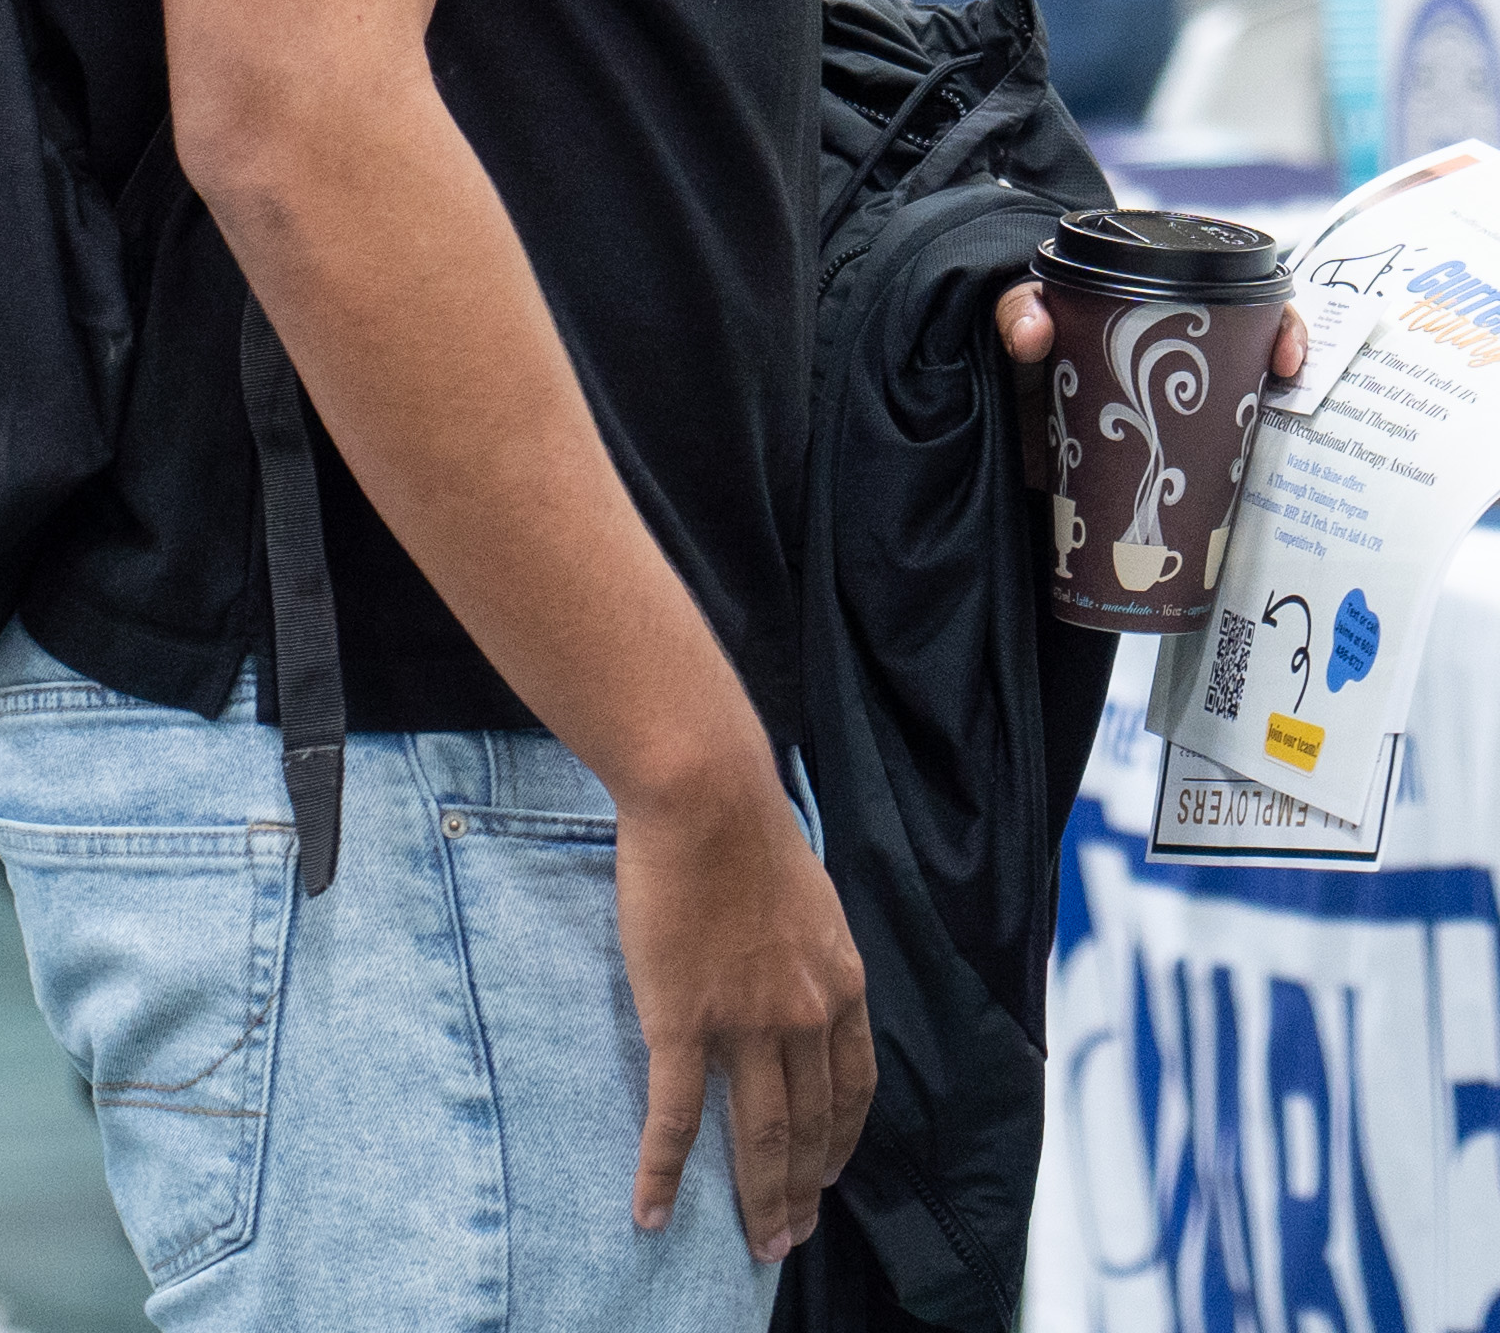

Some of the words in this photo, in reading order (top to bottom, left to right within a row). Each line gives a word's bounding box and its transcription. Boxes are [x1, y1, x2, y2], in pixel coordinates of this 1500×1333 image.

[1341, 366, 1359, 383] art
[1358, 373, 1388, 396] Time
[1384, 385, 1404, 402] Ed
[1399, 391, 1430, 412] Tech
[1359, 342, 1380, 363] Part
[1380, 348, 1410, 373] Time
[1407, 364, 1428, 379] Ed
[1424, 369, 1455, 392] Tech
[1320, 396, 1370, 424] upational
[1369, 410, 1421, 442] Therapists
[1257, 410, 1291, 434] rtified
[1290, 419, 1352, 453] Occupational
[1348, 440, 1389, 469] Therapy
[1388, 457, 1439, 487] Assistants
[1285, 452, 1310, 473] Watch
[1309, 460, 1322, 477] Me
[1320, 466, 1343, 485] Shine
[1266, 472, 1275, 486] A
[1273, 474, 1309, 501] Thorough
[1307, 485, 1339, 513] Training
[1336, 498, 1370, 521] Program
[1273, 526, 1316, 553] Competitive
[1313, 541, 1329, 561] Pay
[1299, 509, 1311, 525] Ed
[1328, 521, 1349, 541] First
[1366, 537, 1385, 553] CPR
[1075, 591, 1095, 609] latte
[1100, 601, 1153, 616] macchiato
[1267, 723, 1284, 743] Join
[1282, 733, 1297, 749] our
[1296, 737, 1320, 758] team!
[1177, 788, 1309, 827] EMPLOYERS
